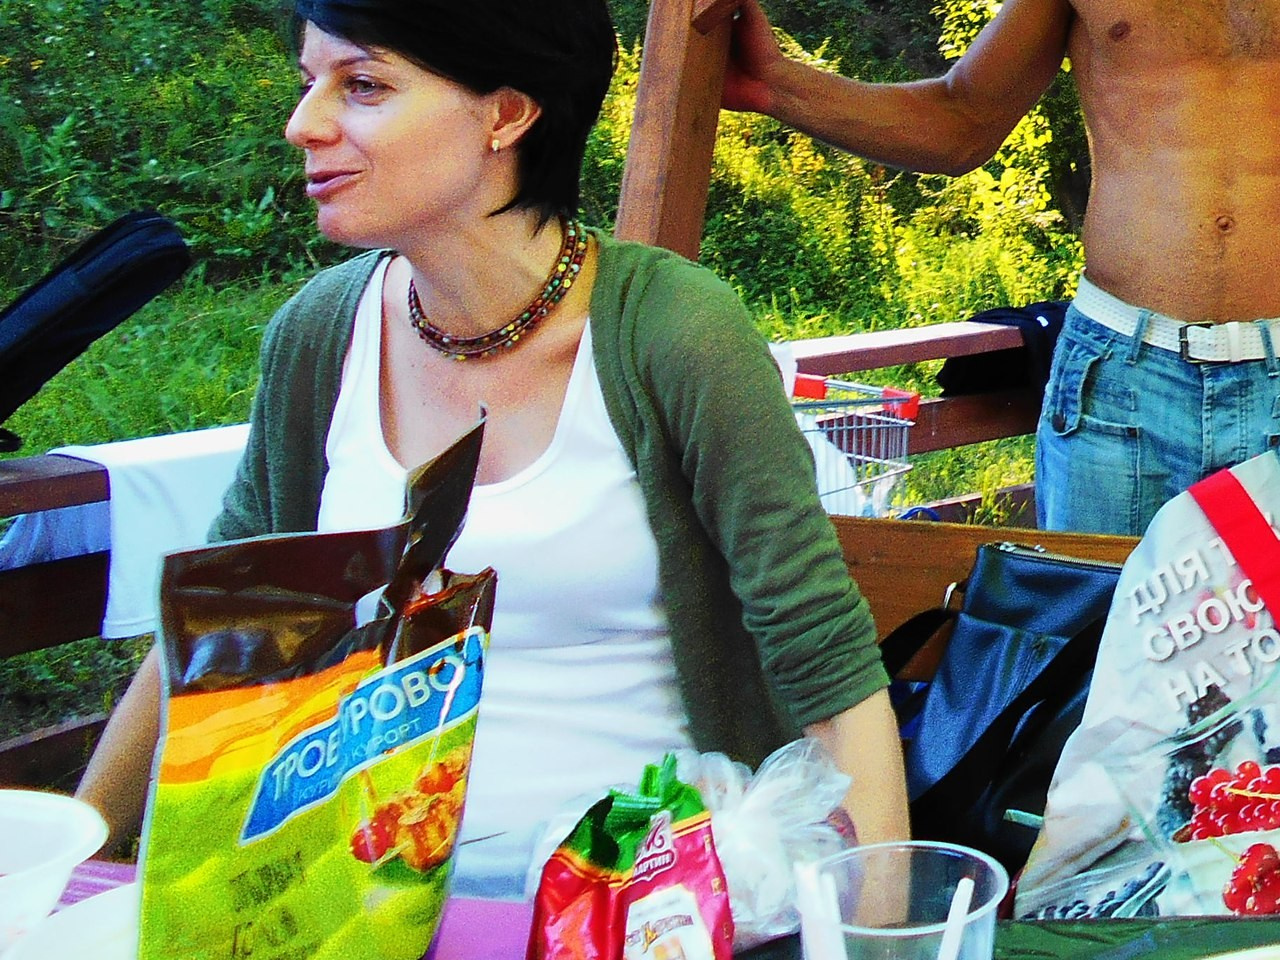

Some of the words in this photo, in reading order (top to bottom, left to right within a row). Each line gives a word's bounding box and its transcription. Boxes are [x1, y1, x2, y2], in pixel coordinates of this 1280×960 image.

[1125, 549, 1209, 625] ДЛЯ
[1147, 578, 1265, 662] СВОЮ
[1167, 660, 1228, 711] НА
